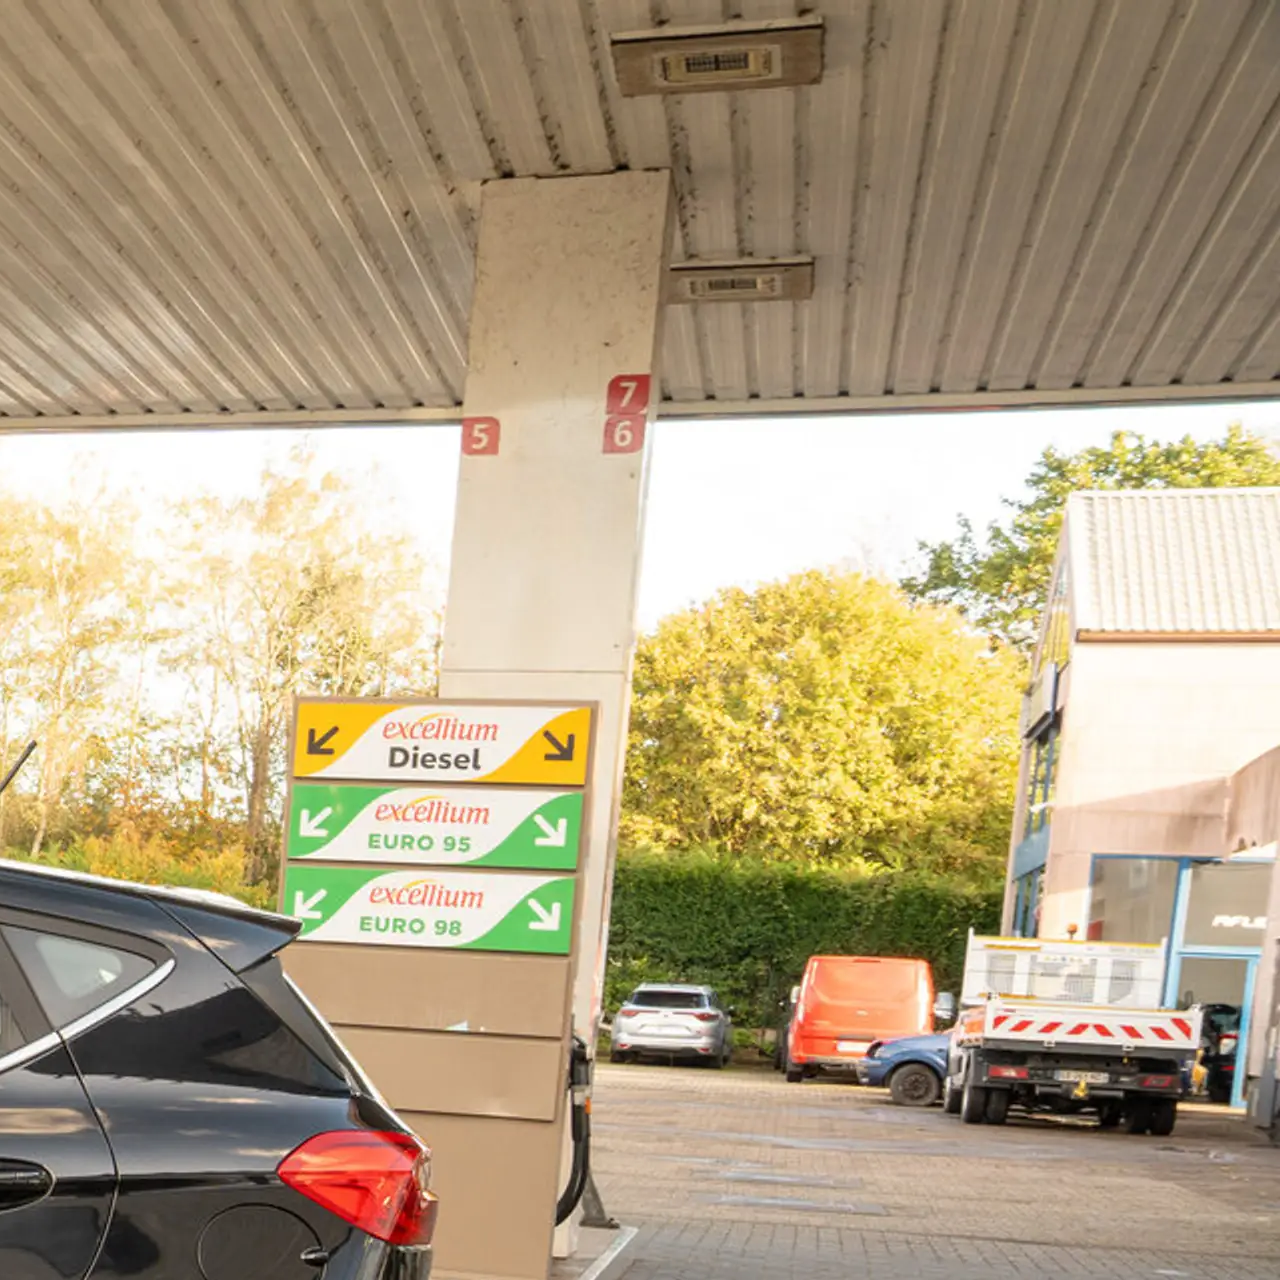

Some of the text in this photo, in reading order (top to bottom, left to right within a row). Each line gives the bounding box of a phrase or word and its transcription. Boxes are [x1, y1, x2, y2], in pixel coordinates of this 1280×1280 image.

[618, 381, 638, 408] 7
[471, 423, 489, 450] 5
[612, 420, 633, 447] 6
[382, 715, 499, 741] excellium
[388, 746, 482, 771] Diesel
[375, 799, 490, 825] excellium
[368, 833, 471, 853] EURO 95
[369, 883, 485, 909] excellium
[359, 916, 462, 937] EURO 98
